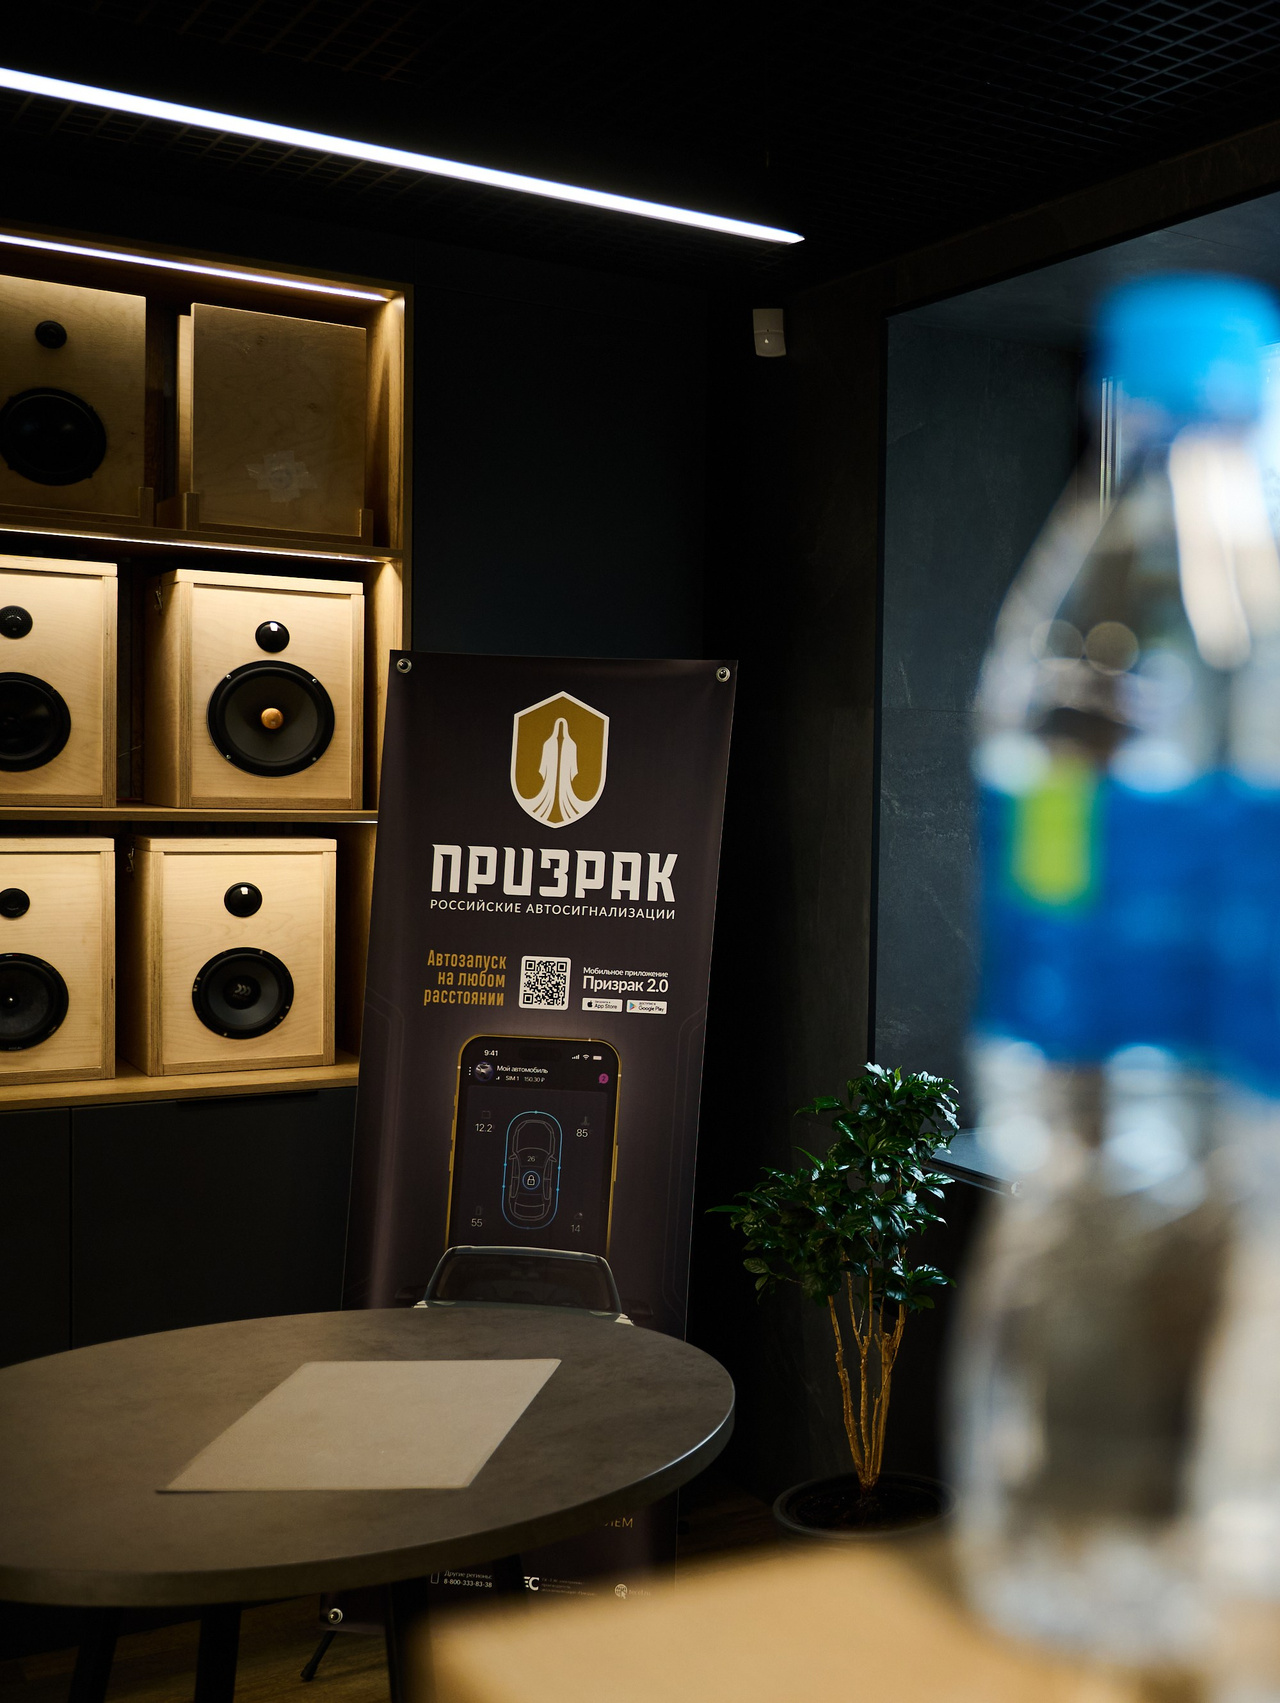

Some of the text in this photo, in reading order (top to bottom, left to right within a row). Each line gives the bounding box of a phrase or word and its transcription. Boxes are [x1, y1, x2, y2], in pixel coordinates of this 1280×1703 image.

[431, 843, 678, 903] ПРИЗРАК
[429, 899, 676, 921] РОССИЙСКИЕ АВТОСИГНАЛИЗАЦИИ
[427, 949, 507, 971] Автозапуск
[583, 966, 669, 978] Мобильное приложение
[437, 971, 506, 988] на любом
[583, 975, 669, 994] Призрак 2.0
[423, 989, 505, 1007] расстоянии
[484, 1049, 499, 1057] 9:41
[496, 1064, 549, 1075] Мой автомобиль
[475, 1123, 493, 1133] 12.2
[576, 1128, 589, 1138] 85
[527, 1155, 536, 1163] 26
[471, 1218, 483, 1228] 55
[570, 1224, 581, 1233] 14
[443, 1578, 493, 1588] 8-800-333-83-38
